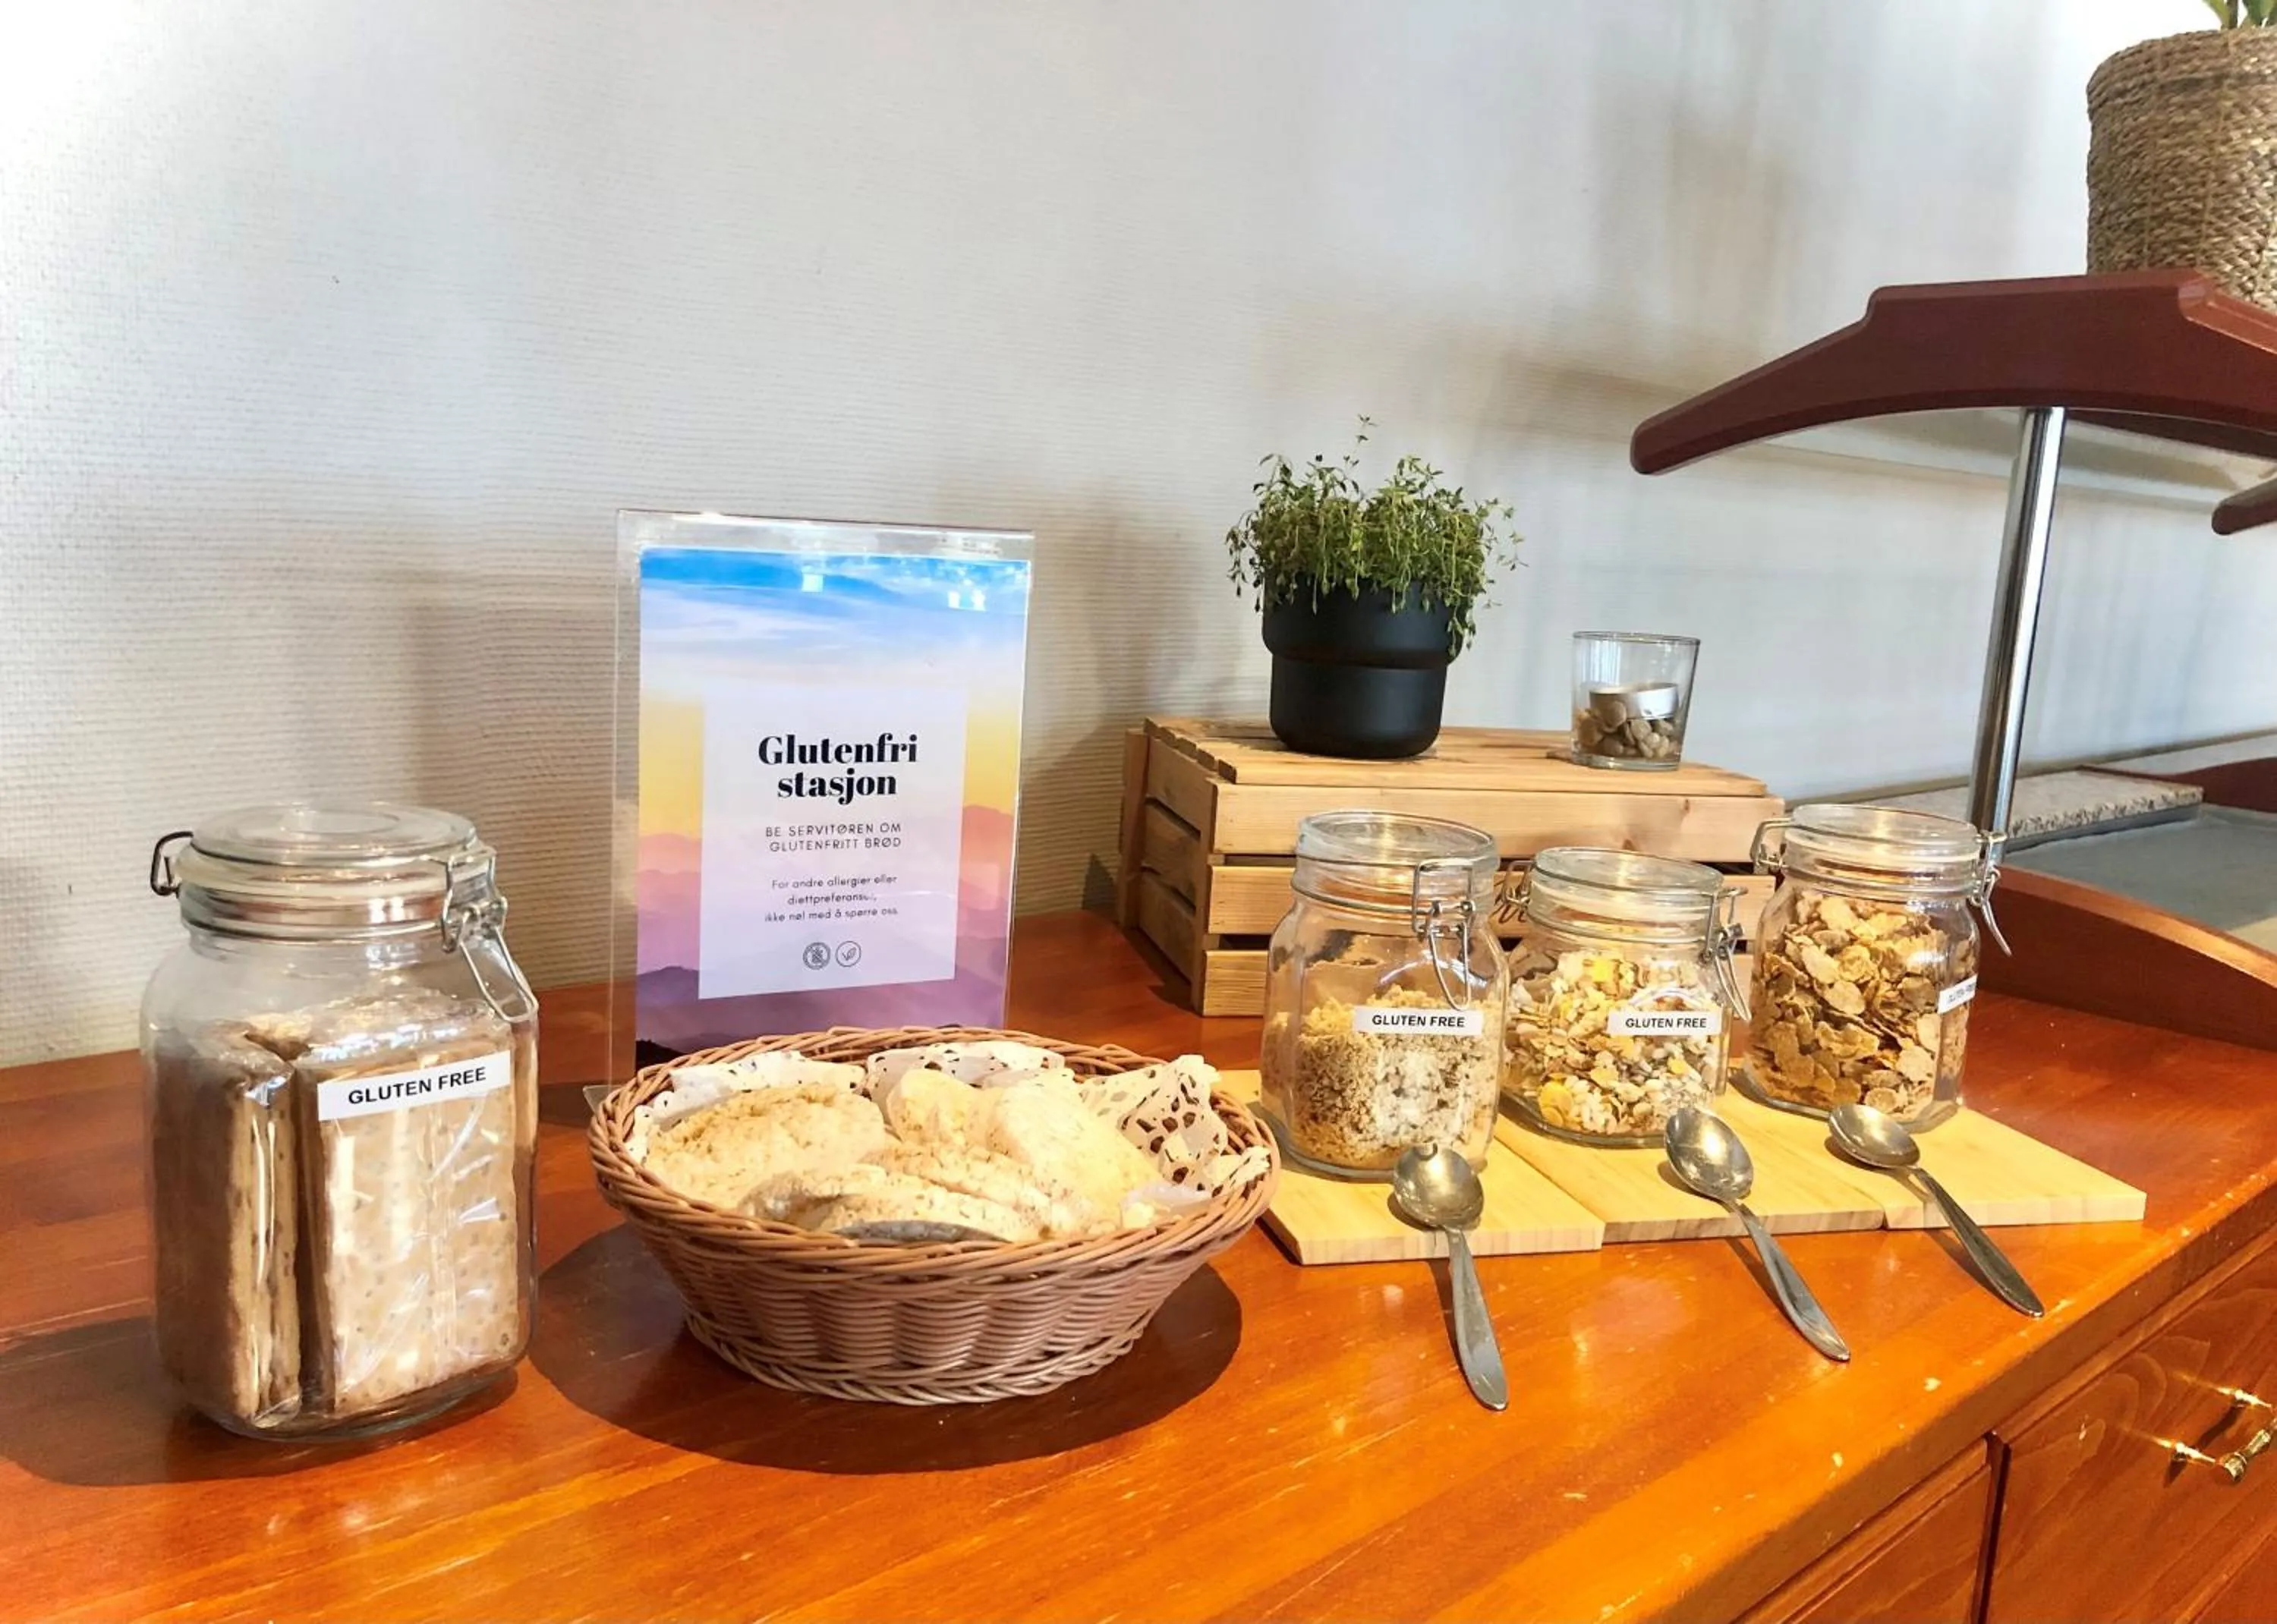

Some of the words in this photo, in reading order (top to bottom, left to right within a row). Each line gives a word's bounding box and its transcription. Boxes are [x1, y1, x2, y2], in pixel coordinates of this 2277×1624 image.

[758, 733, 918, 765] Glutenfri
[777, 768, 897, 804] stasjon
[766, 826, 782, 837] BE
[789, 823, 874, 837] SERVITØREN
[880, 822, 901, 833] OM
[770, 839, 858, 852] GLUTENFRITT
[865, 837, 901, 848] BRØD
[772, 879, 789, 889] For
[792, 877, 824, 889] andre
[827, 875, 871, 889] allergier
[874, 873, 897, 884] eller
[764, 911, 786, 922] ikke
[789, 911, 805, 921] nøl
[808, 909, 831, 920] med
[834, 908, 842, 918] å
[845, 908, 878, 920] spørre
[1372, 1015, 1426, 1027] GLUTEN
[1430, 1015, 1466, 1028] FREE
[1625, 1018, 1674, 1028] GLUTEN
[1677, 1018, 1707, 1028] FREE
[348, 1078, 432, 1104] GLUTEN
[438, 1066, 487, 1091] FREE
